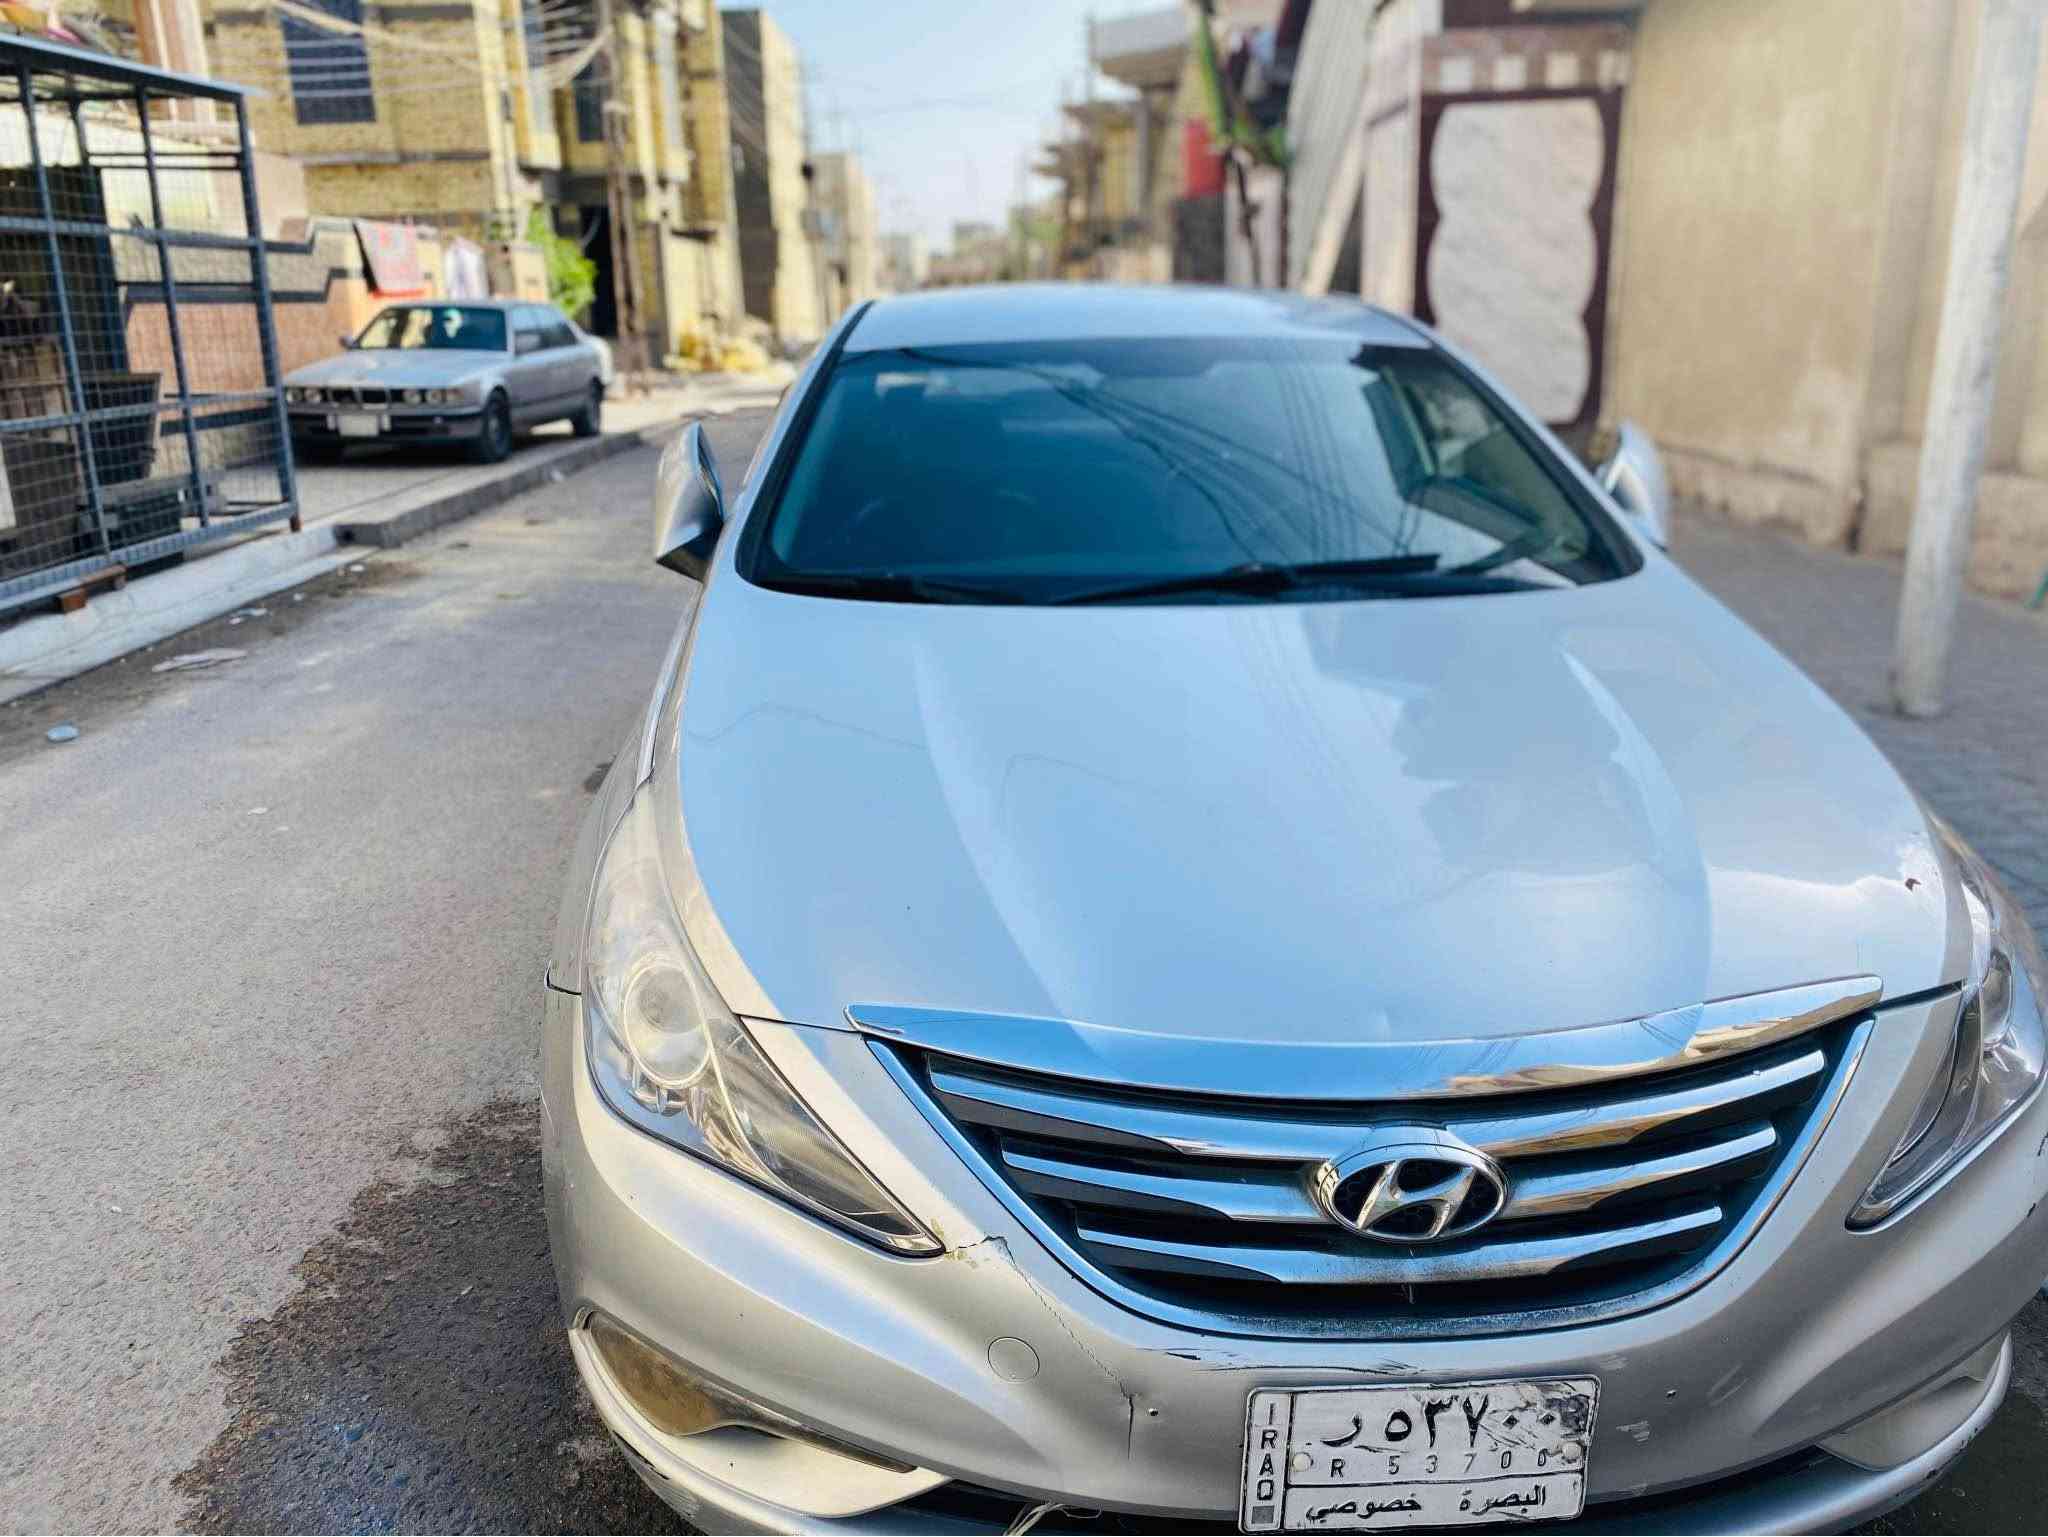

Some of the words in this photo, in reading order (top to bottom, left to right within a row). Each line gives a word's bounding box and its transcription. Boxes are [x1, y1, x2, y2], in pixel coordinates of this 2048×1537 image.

[1256, 1402, 1276, 1500] IRAQ
[1330, 1458, 1345, 1478] R
[1305, 1493, 1422, 1523] خصوصي
[1459, 1484, 1546, 1516] البصرة
